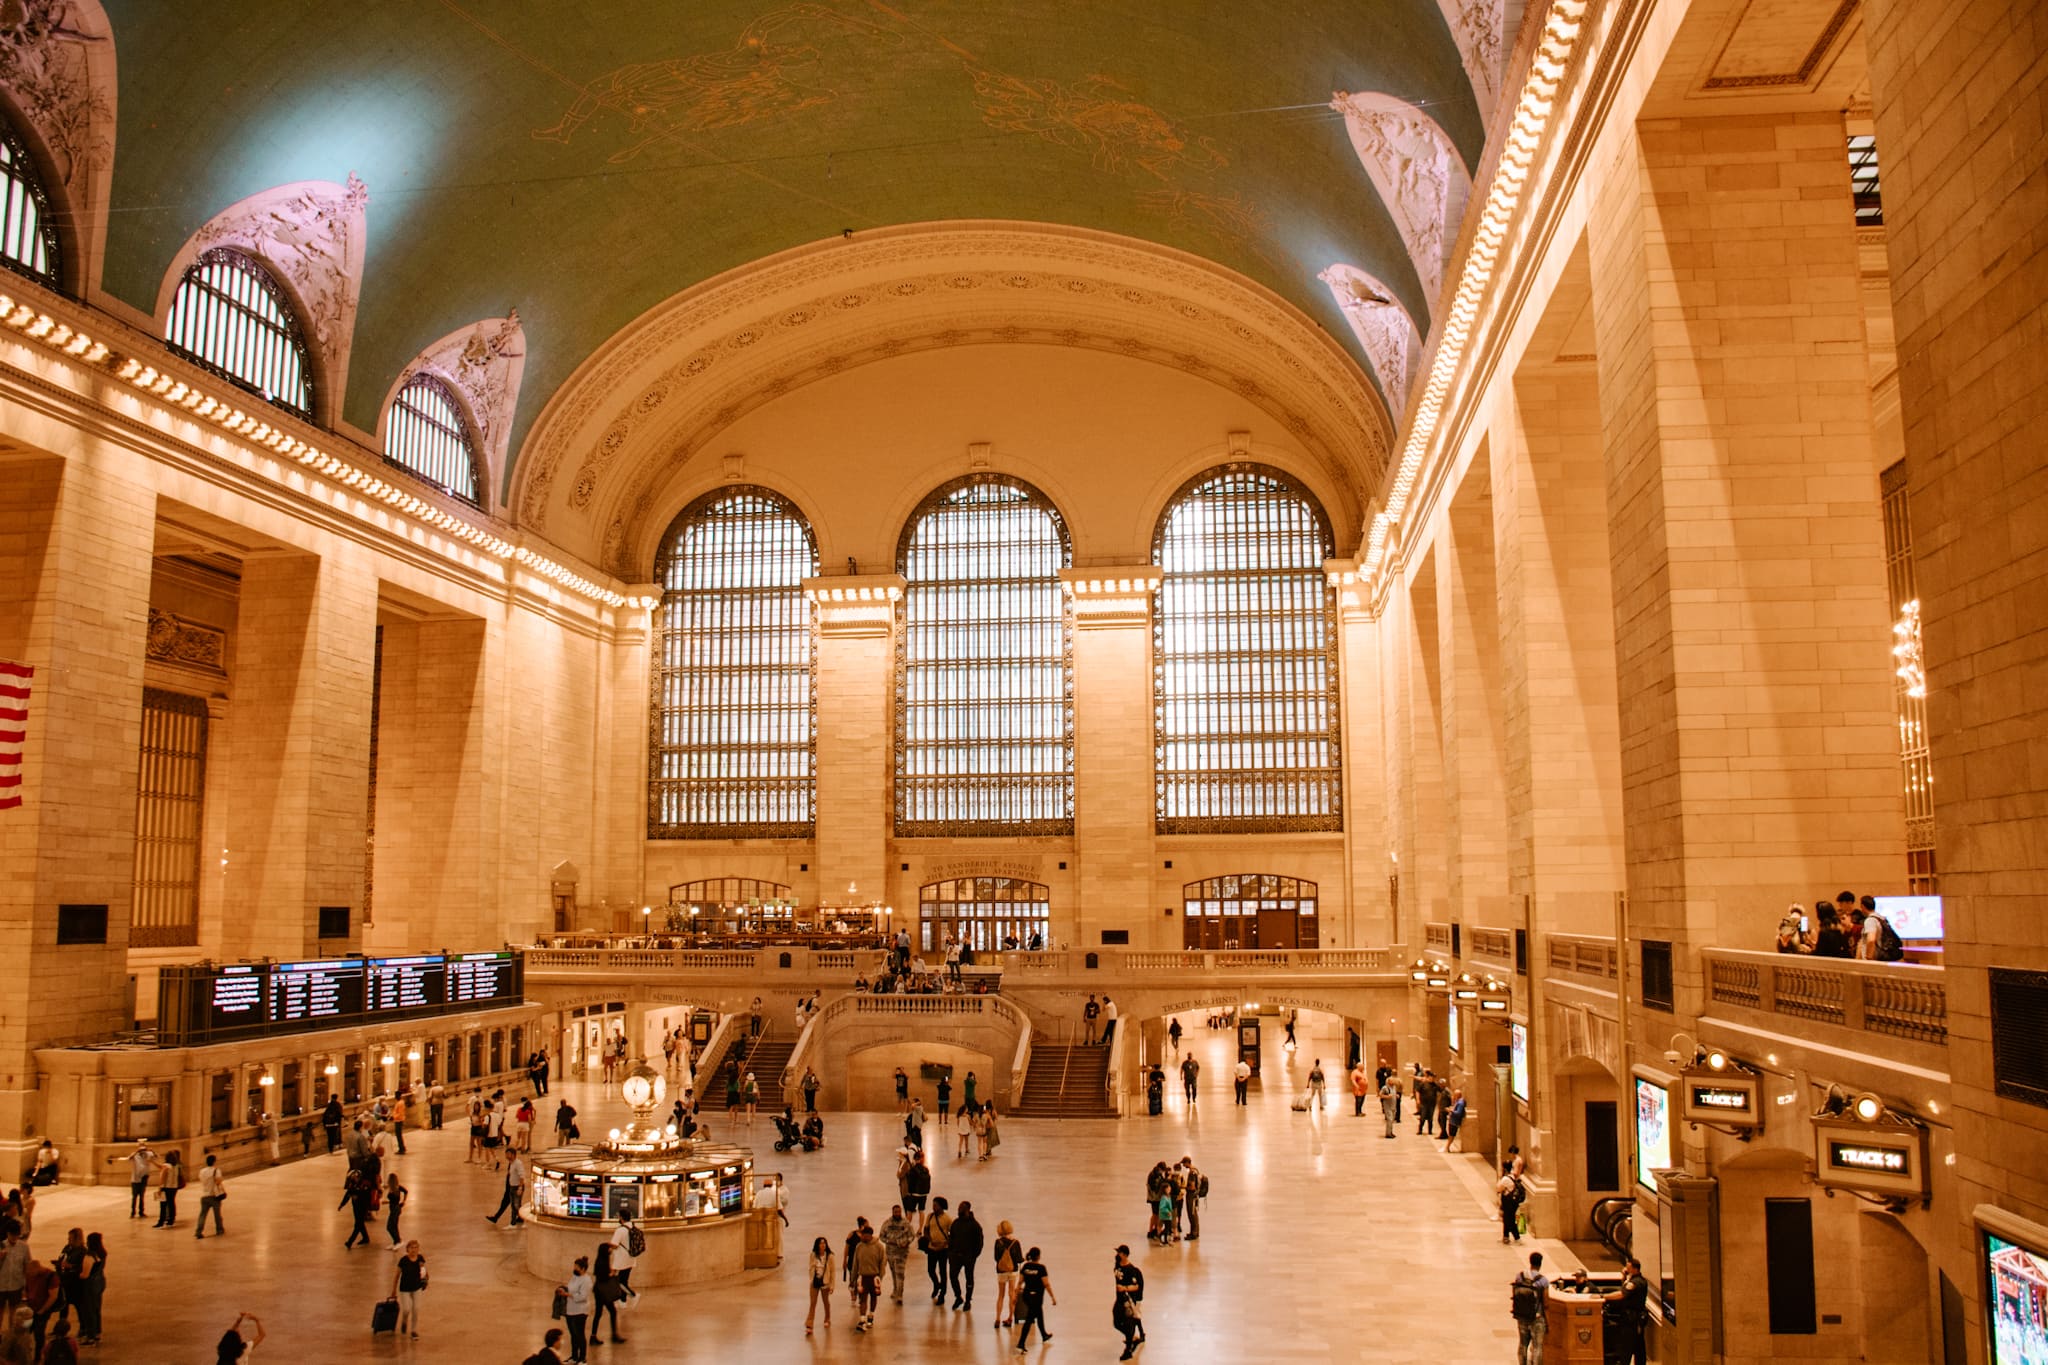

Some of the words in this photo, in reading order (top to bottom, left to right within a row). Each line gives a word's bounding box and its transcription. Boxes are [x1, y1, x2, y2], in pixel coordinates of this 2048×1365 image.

[933, 865, 943, 873] TO
[948, 860, 997, 869] VANDERBILT
[1003, 861, 1034, 871] AVENUE
[927, 871, 944, 881] THE
[947, 867, 988, 877] CAMPBELL
[992, 868, 1041, 880] APARTMENT
[652, 993, 682, 1003] SUBWAY
[1162, 1000, 1191, 1013] TICKET
[1194, 995, 1238, 1007] MACHINES
[1268, 996, 1300, 1006] TRACKS
[1312, 1000, 1324, 1009] TO
[1325, 1003, 1335, 1011] 42
[1700, 1094, 1732, 1107] TRACK
[1839, 1149, 1885, 1168] TRACK
[1885, 1152, 1904, 1169] 24
